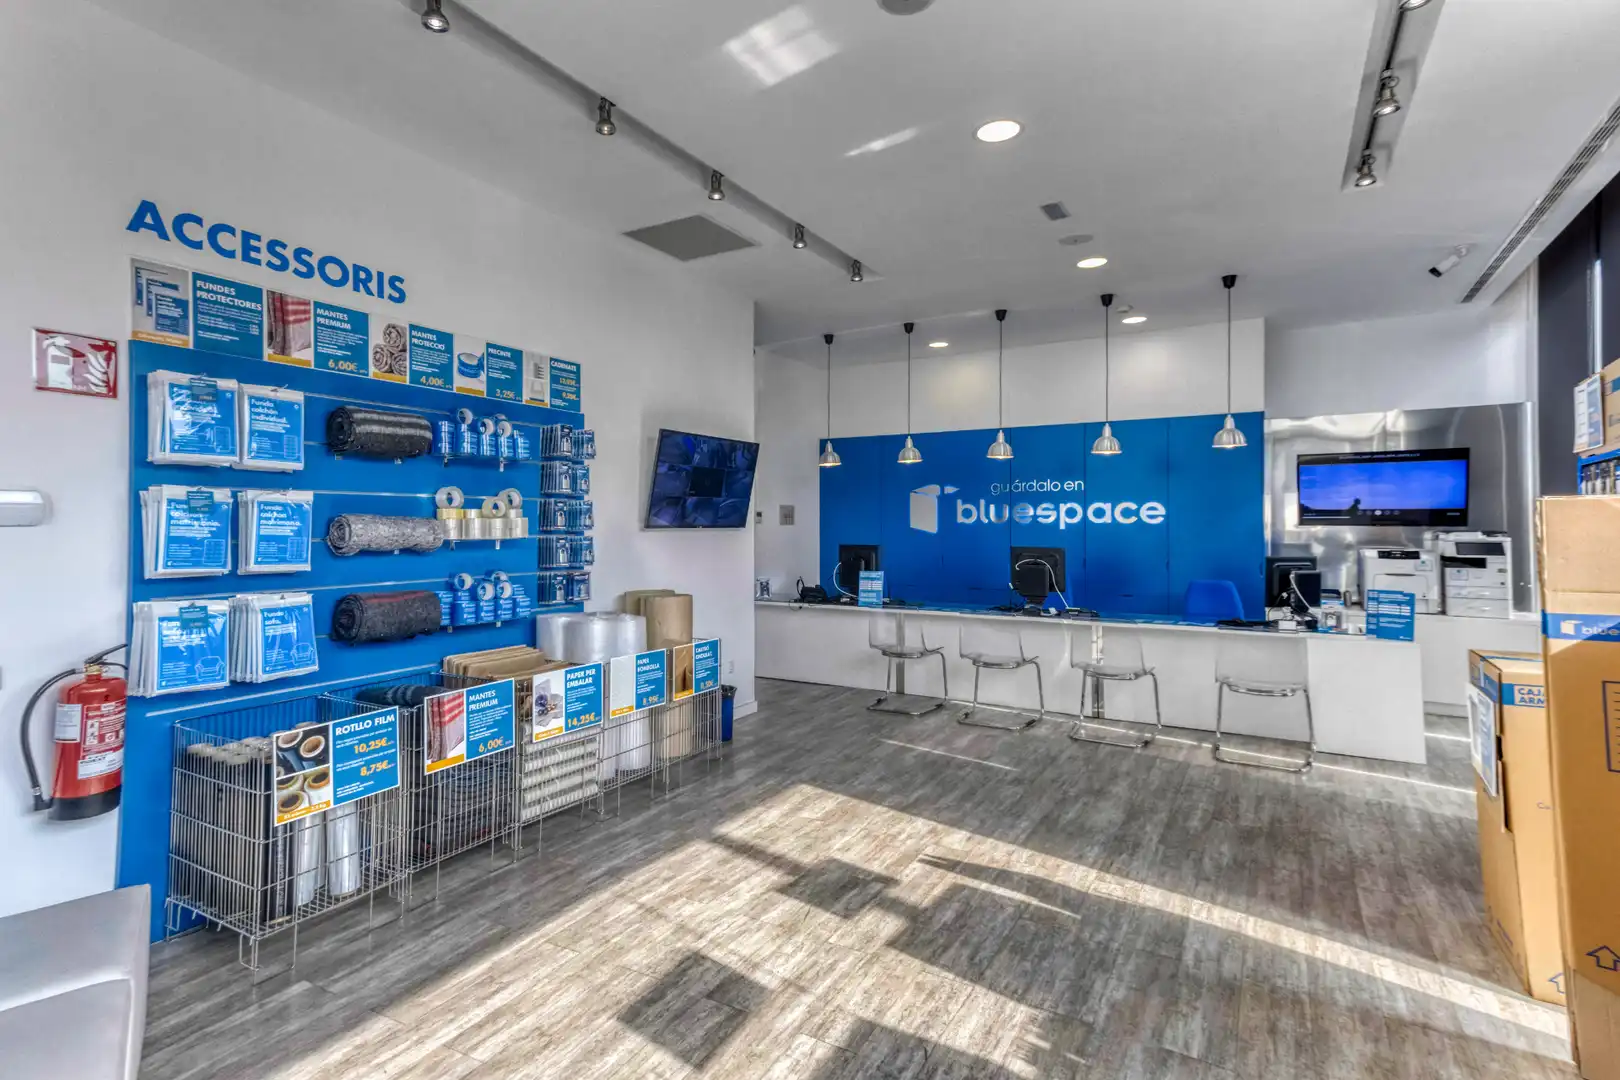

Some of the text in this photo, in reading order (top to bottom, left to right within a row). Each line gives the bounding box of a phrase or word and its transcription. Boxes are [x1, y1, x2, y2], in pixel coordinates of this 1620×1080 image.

[125, 199, 408, 304] ACCESSORIS
[196, 280, 236, 295] FUNDES
[196, 290, 262, 311] PROTECTORES
[316, 307, 348, 321] MANTES
[316, 317, 351, 330] PREMIUM
[412, 330, 437, 341] MANTES
[412, 338, 445, 351] PROTECCIÓ
[328, 358, 357, 372] 6,00€
[420, 375, 445, 388] 4,00€
[991, 479, 1085, 495] guárdalo en
[956, 499, 1166, 530] bluespace
[566, 671, 585, 681] PAPER
[468, 689, 496, 703] MANTES
[468, 698, 499, 712] PREMIUM
[335, 714, 395, 736] ROTLLO FILM
[567, 712, 596, 728] 14,25€
[353, 736, 388, 754] 10,25€
[478, 736, 505, 753] 6,00€
[360, 760, 389, 777] 8,75€
